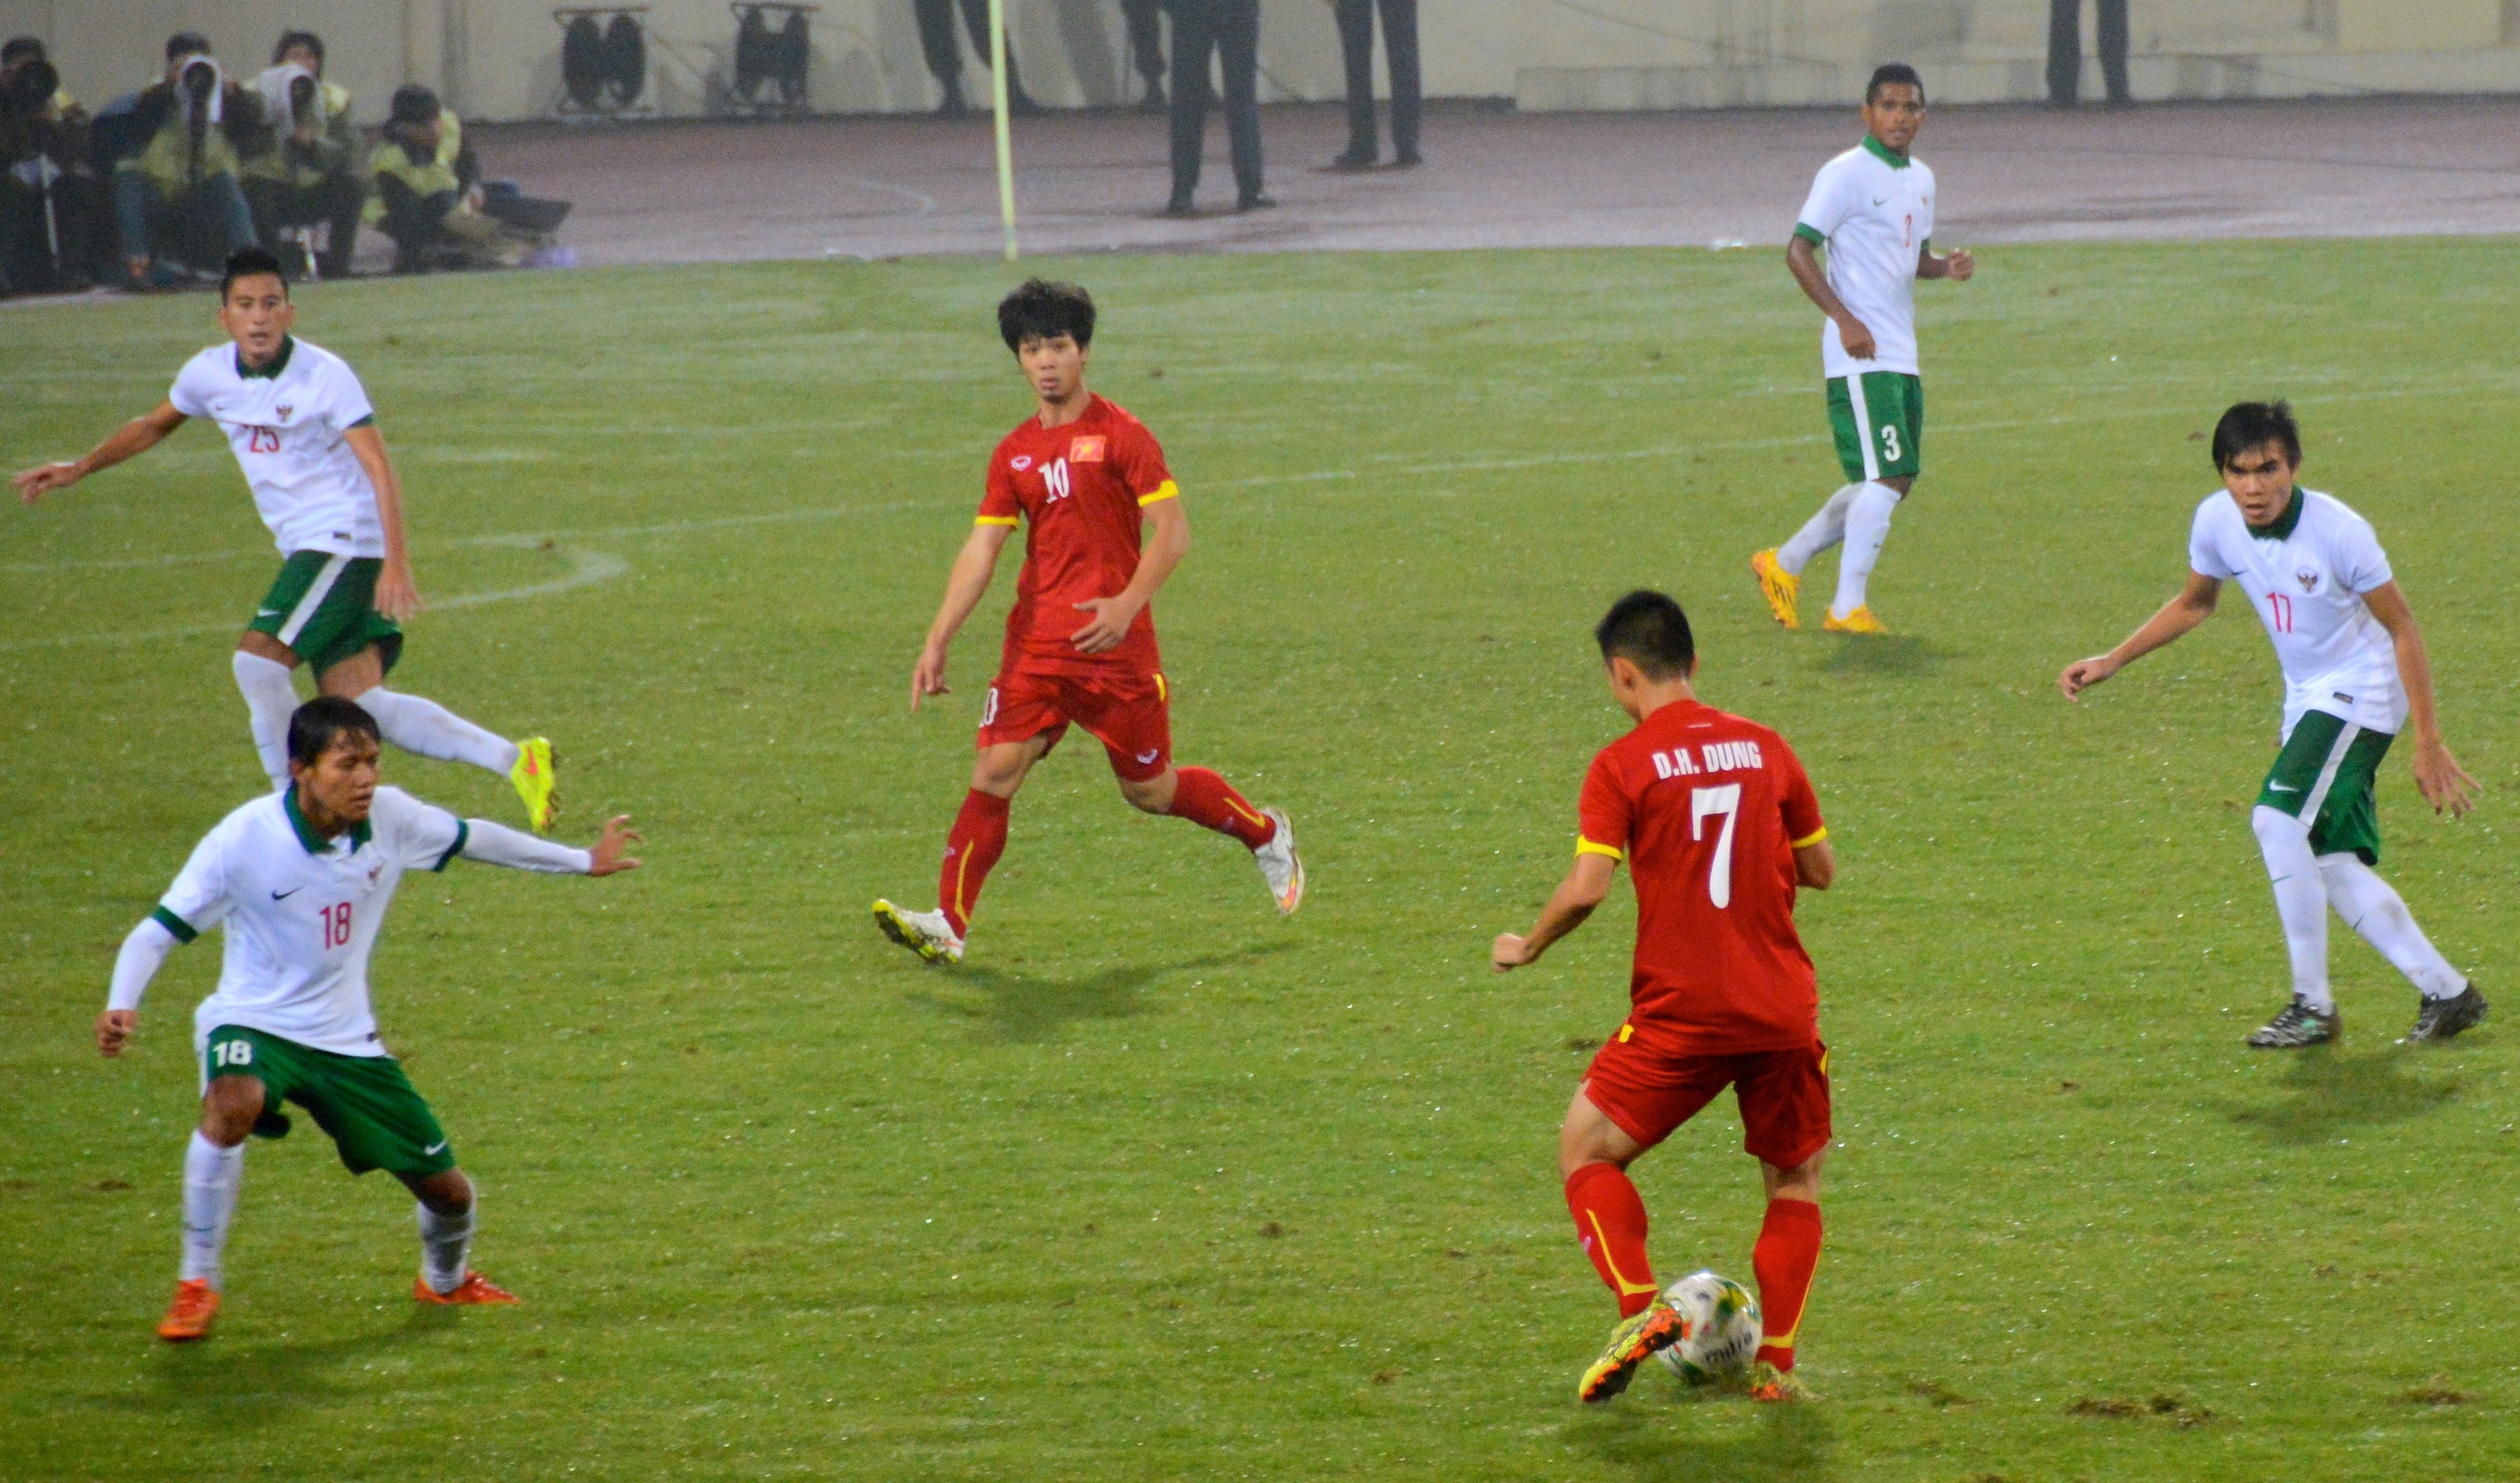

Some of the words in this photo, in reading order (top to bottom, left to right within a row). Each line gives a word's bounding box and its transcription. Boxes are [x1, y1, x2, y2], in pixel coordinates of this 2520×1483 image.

[243, 424, 280, 453] 25
[1882, 425, 1901, 462] 3
[1038, 457, 1070, 504] 10
[2267, 592, 2292, 633] 17
[1652, 752, 1700, 779] D.H.
[1702, 742, 1763, 773] DUNG
[1692, 783, 1740, 909] 7
[319, 902, 351, 950] 18
[213, 1040, 253, 1068] 18
